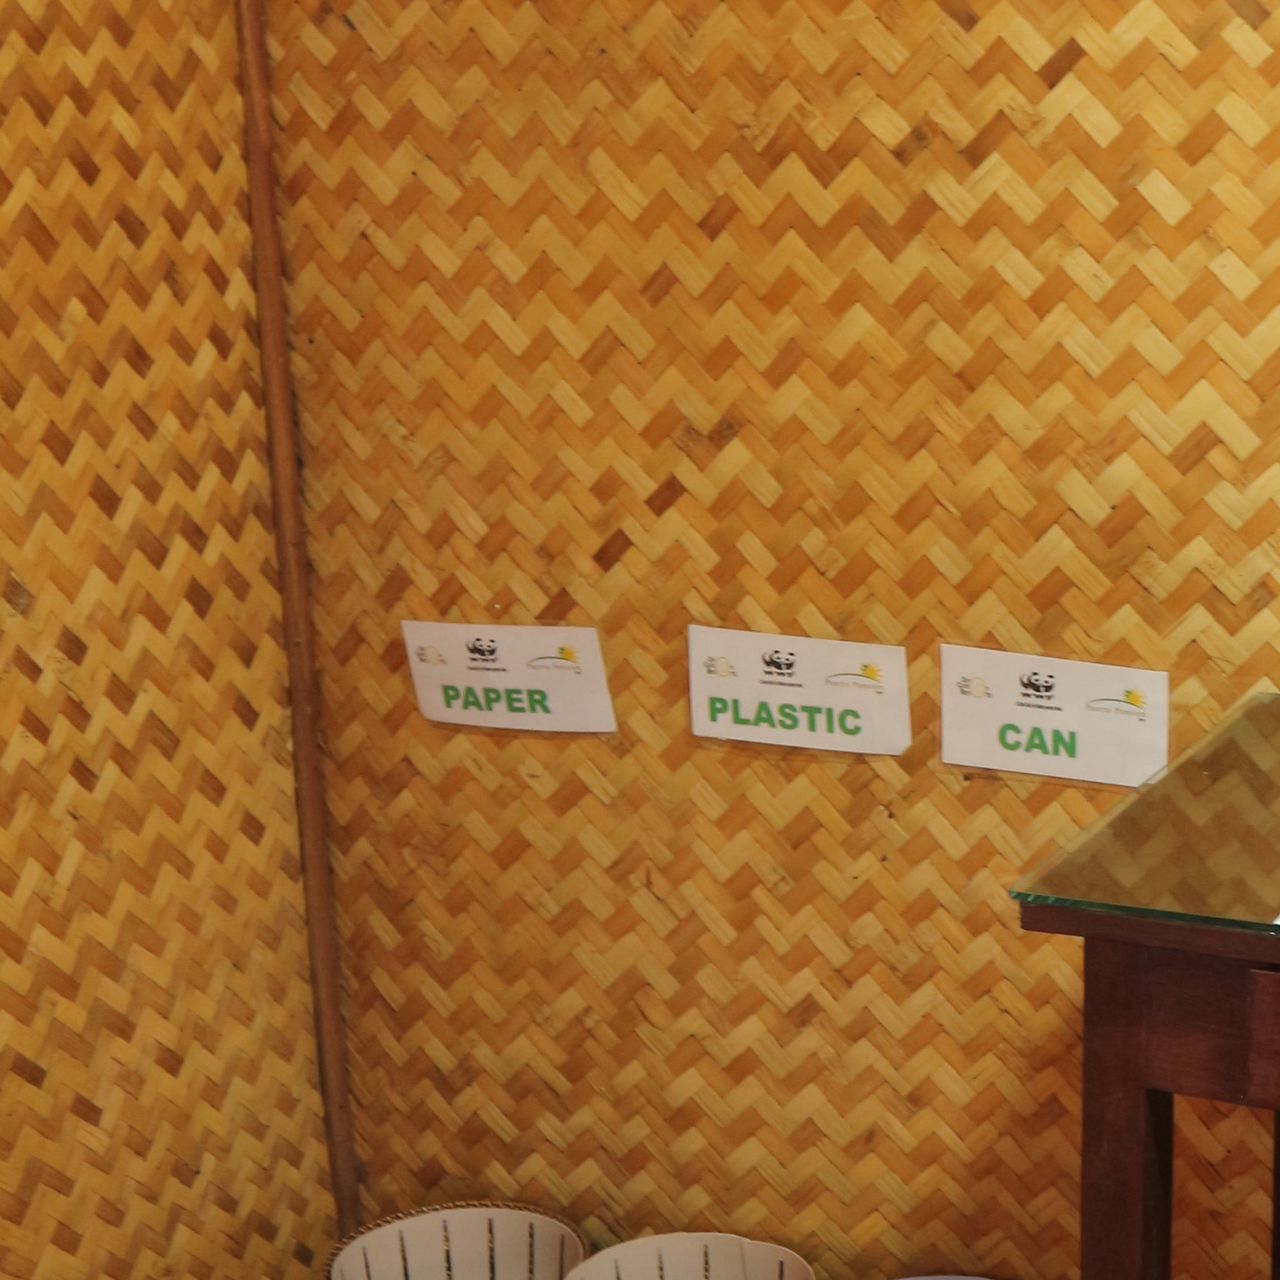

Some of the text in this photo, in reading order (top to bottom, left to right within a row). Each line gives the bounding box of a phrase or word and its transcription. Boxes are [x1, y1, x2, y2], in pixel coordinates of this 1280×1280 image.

[441, 685, 552, 714] PAPER
[709, 696, 862, 736] PLASTIC
[998, 723, 1077, 758] CAN
